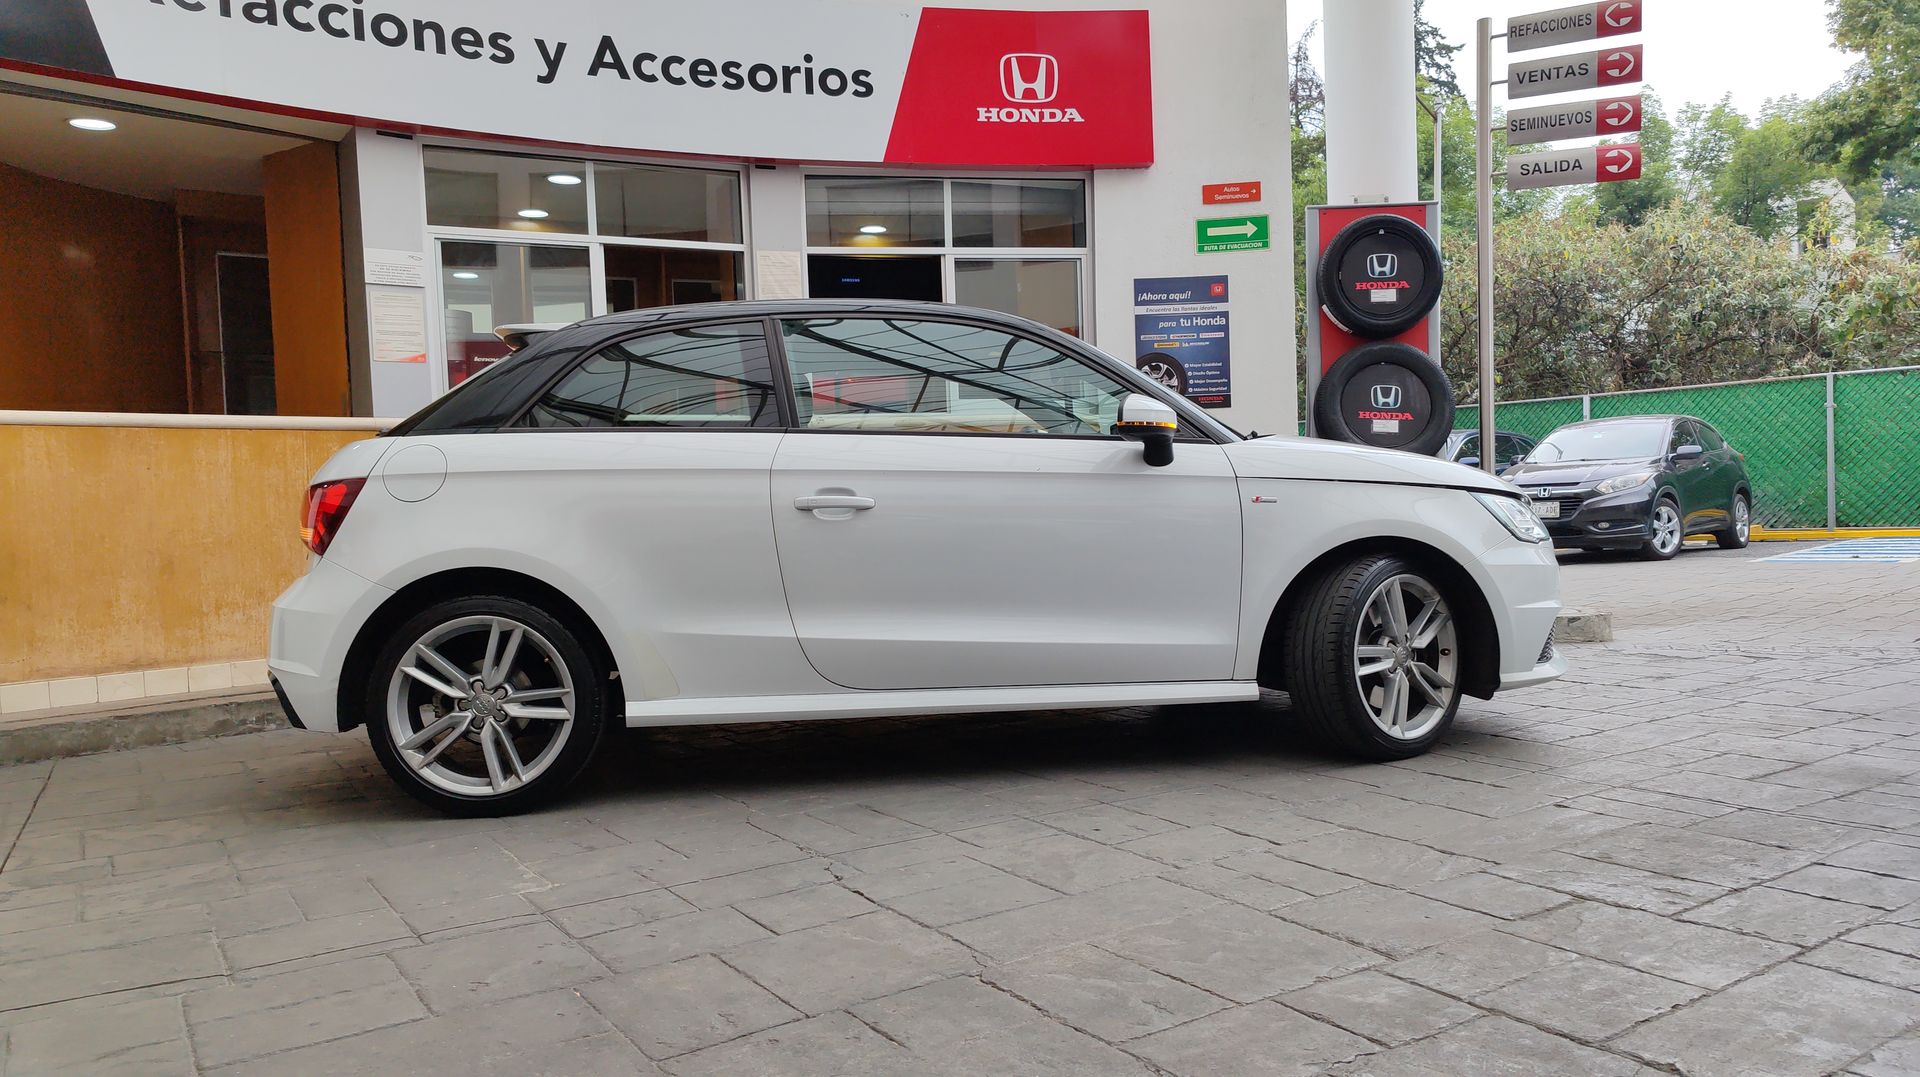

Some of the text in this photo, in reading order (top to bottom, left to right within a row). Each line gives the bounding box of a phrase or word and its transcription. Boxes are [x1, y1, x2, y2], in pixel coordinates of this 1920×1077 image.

[1510, 13, 1592, 38] REFACCIONES
[534, 38, 568, 84] y
[587, 35, 874, 98] Accesorios
[1516, 62, 1589, 84] VENTAS
[976, 108, 1085, 122] HONDA
[1510, 110, 1592, 132] SEMINUEVOS
[1520, 158, 1582, 176] SALIDA
[1355, 281, 1410, 289] HONDA
[1138, 291, 1192, 301] ¡Ahora aquí!
[1180, 318, 1190, 326] tu
[1192, 316, 1226, 326] Honda
[1358, 411, 1414, 420] HONDA
